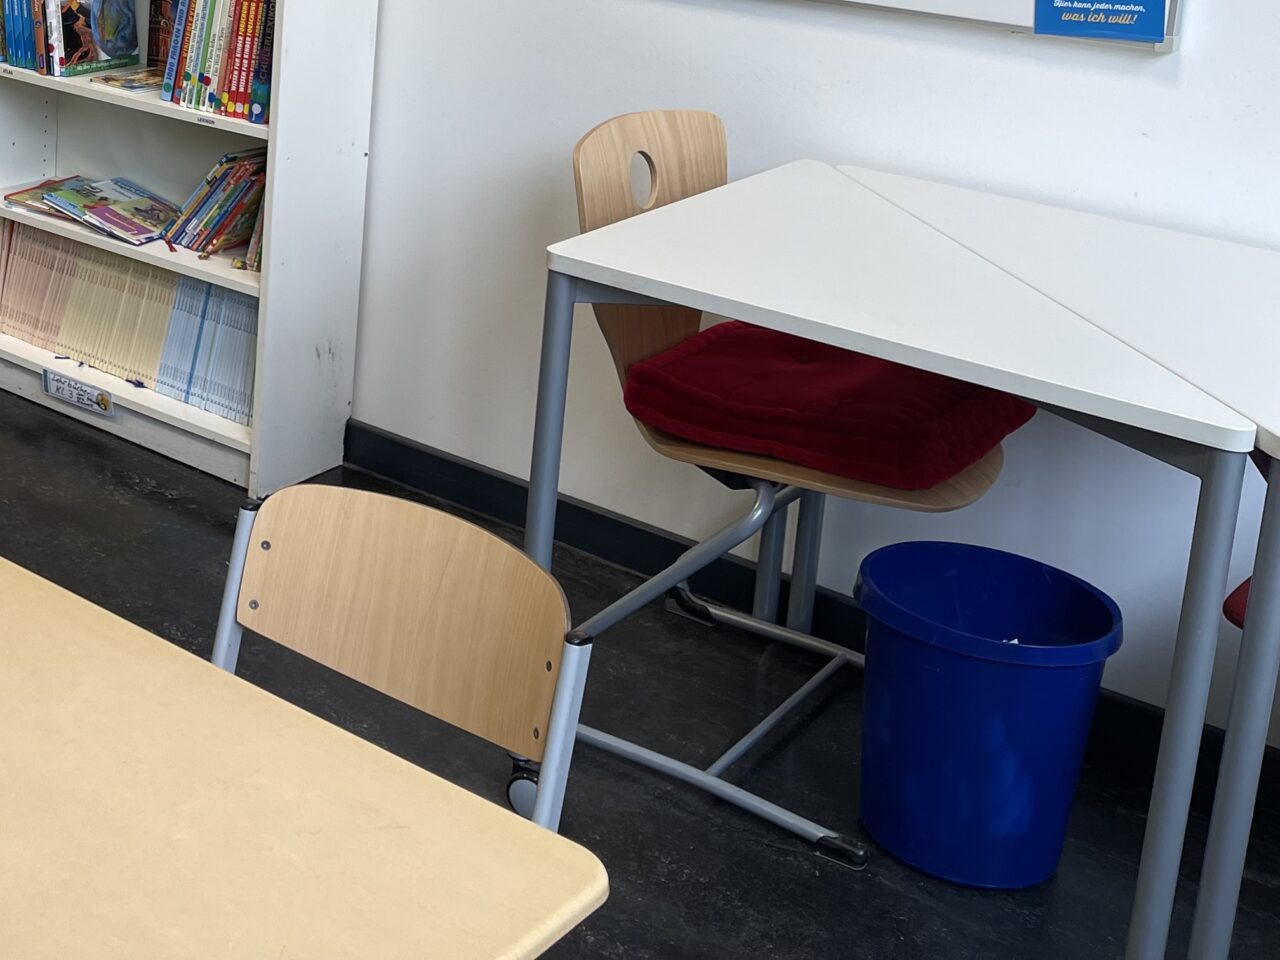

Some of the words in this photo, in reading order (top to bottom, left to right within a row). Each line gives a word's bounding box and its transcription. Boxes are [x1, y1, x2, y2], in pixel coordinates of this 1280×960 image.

[1073, 0, 1092, 9] kann
[1092, 1, 1113, 11] jeder
[1061, 12, 1086, 22] was
[1088, 12, 1106, 23] ich
[1108, 14, 1138, 25] will!
